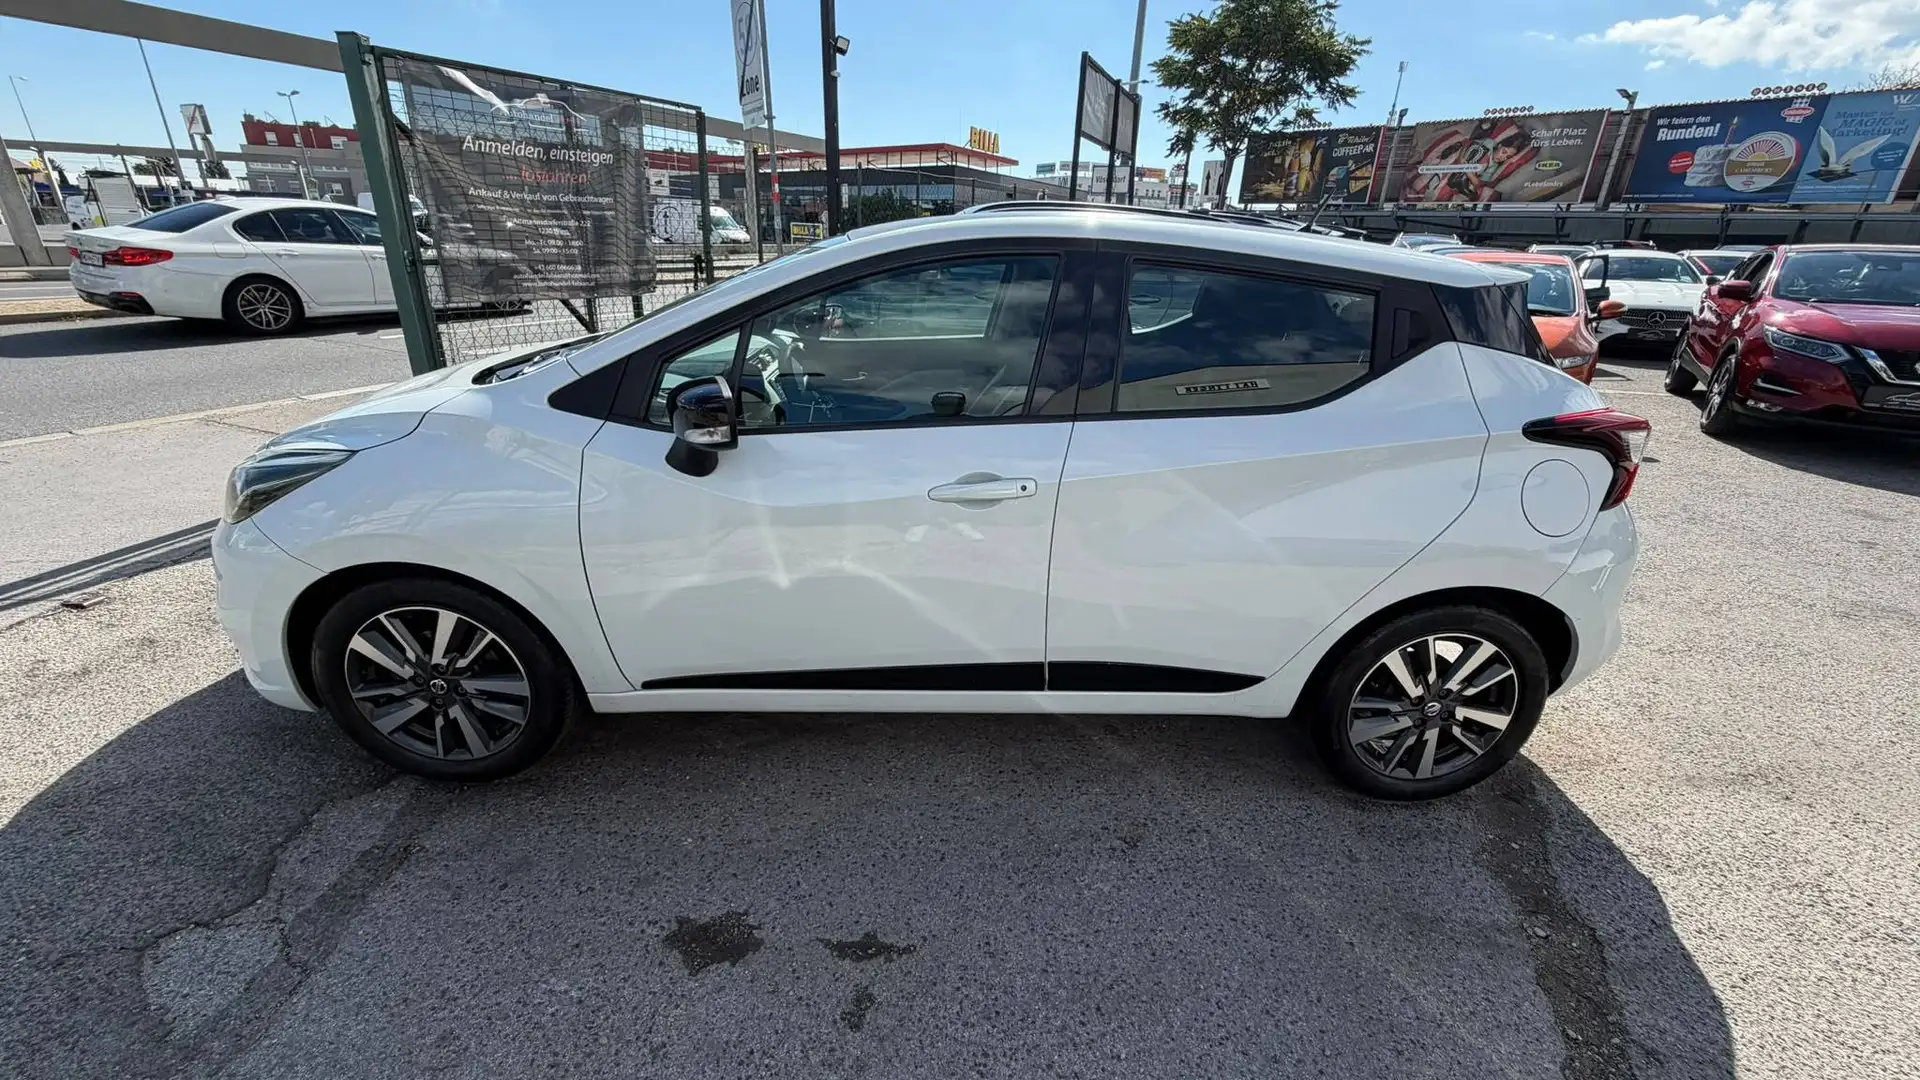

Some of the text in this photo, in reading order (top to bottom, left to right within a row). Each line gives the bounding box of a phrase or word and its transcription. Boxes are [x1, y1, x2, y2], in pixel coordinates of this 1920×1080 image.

[1657, 115, 1711, 126] Wir feiern den
[1531, 127, 1588, 138] Schaff Platz
[1656, 123, 1721, 141] Runden!
[970, 126, 999, 154] BILLA
[1530, 138, 1583, 148] fürs Leben.
[462, 135, 614, 167] Anmelden, einsteigen
[1095, 175, 1127, 184] Vösdorf
[469, 187, 503, 198] Ankauf
[503, 191, 510, 199] &
[510, 190, 541, 201] Verkauf
